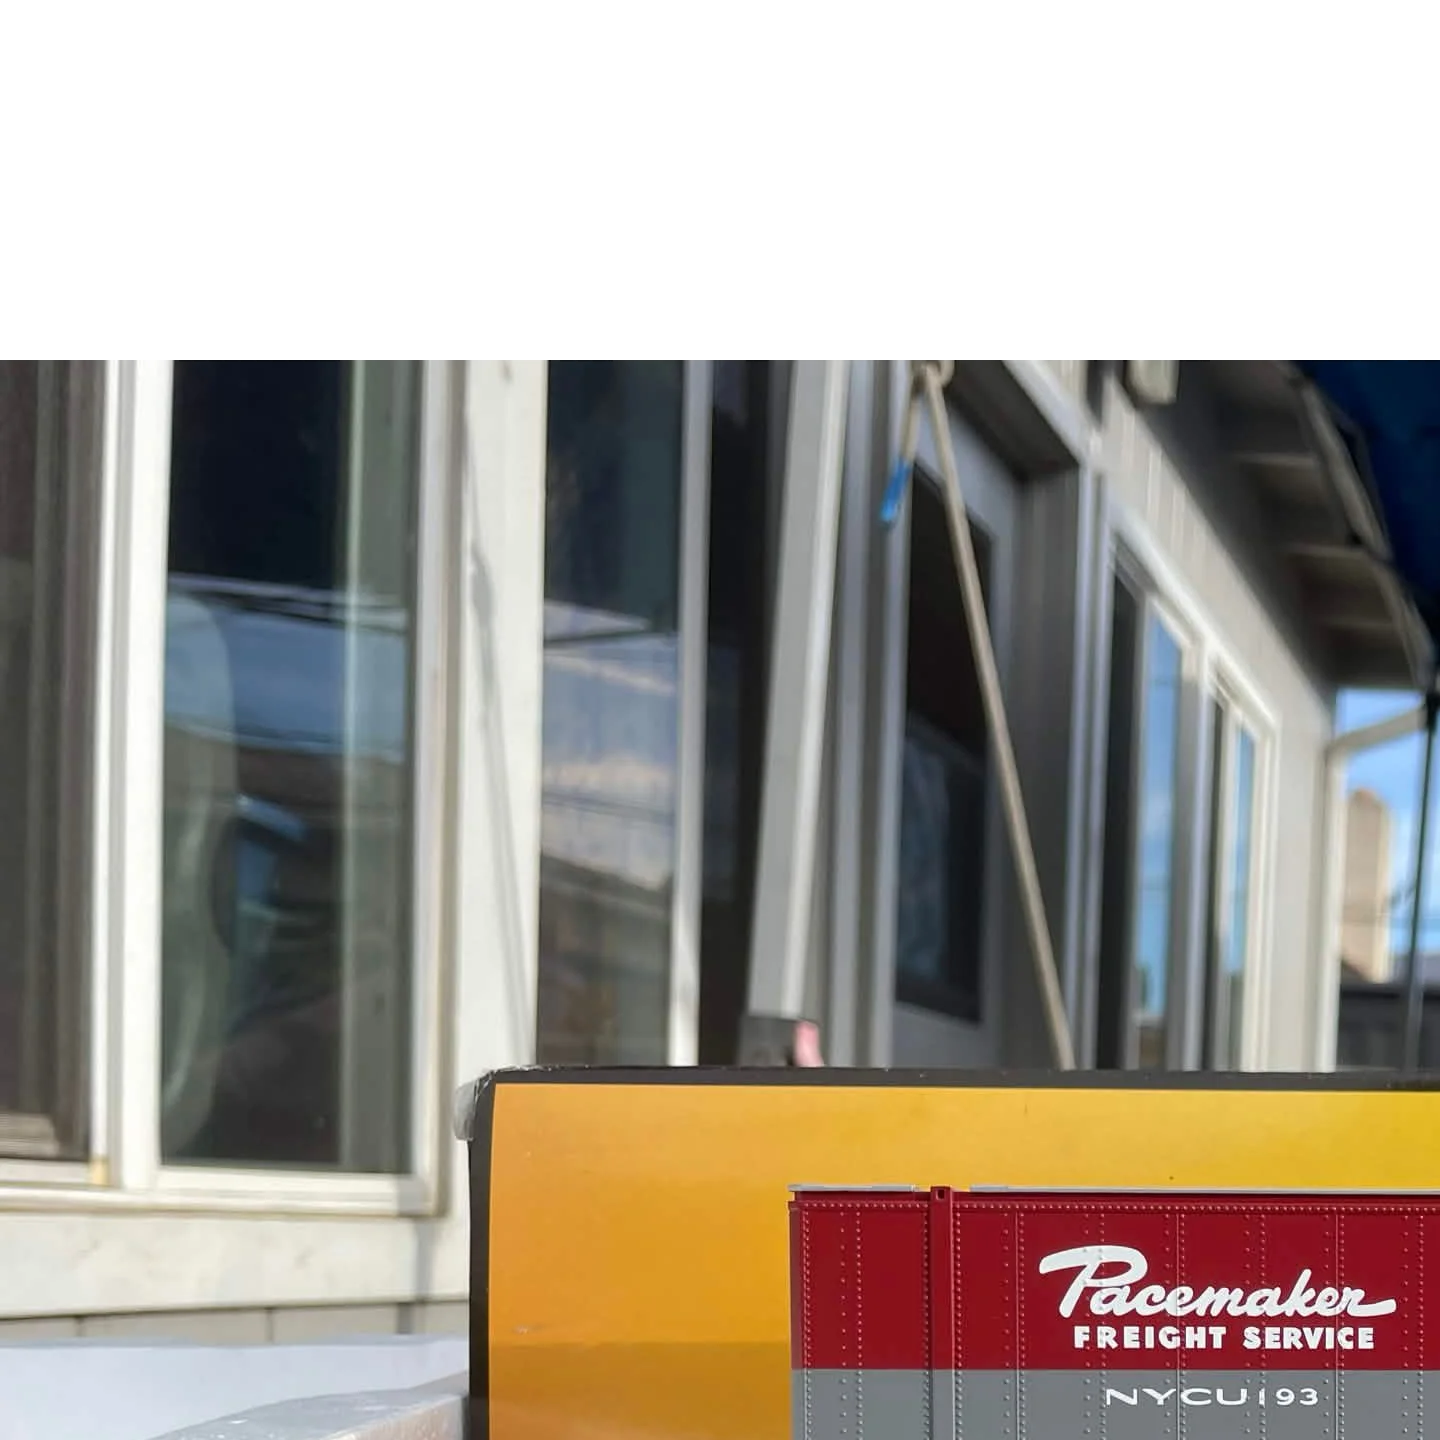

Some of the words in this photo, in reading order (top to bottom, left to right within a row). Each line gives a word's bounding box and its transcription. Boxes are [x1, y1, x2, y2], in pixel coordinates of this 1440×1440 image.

[1038, 1245, 1397, 1318] Pacemaker
[1073, 1325, 1227, 1350] FREIGHT
[1243, 1325, 1375, 1350] SERVICE
